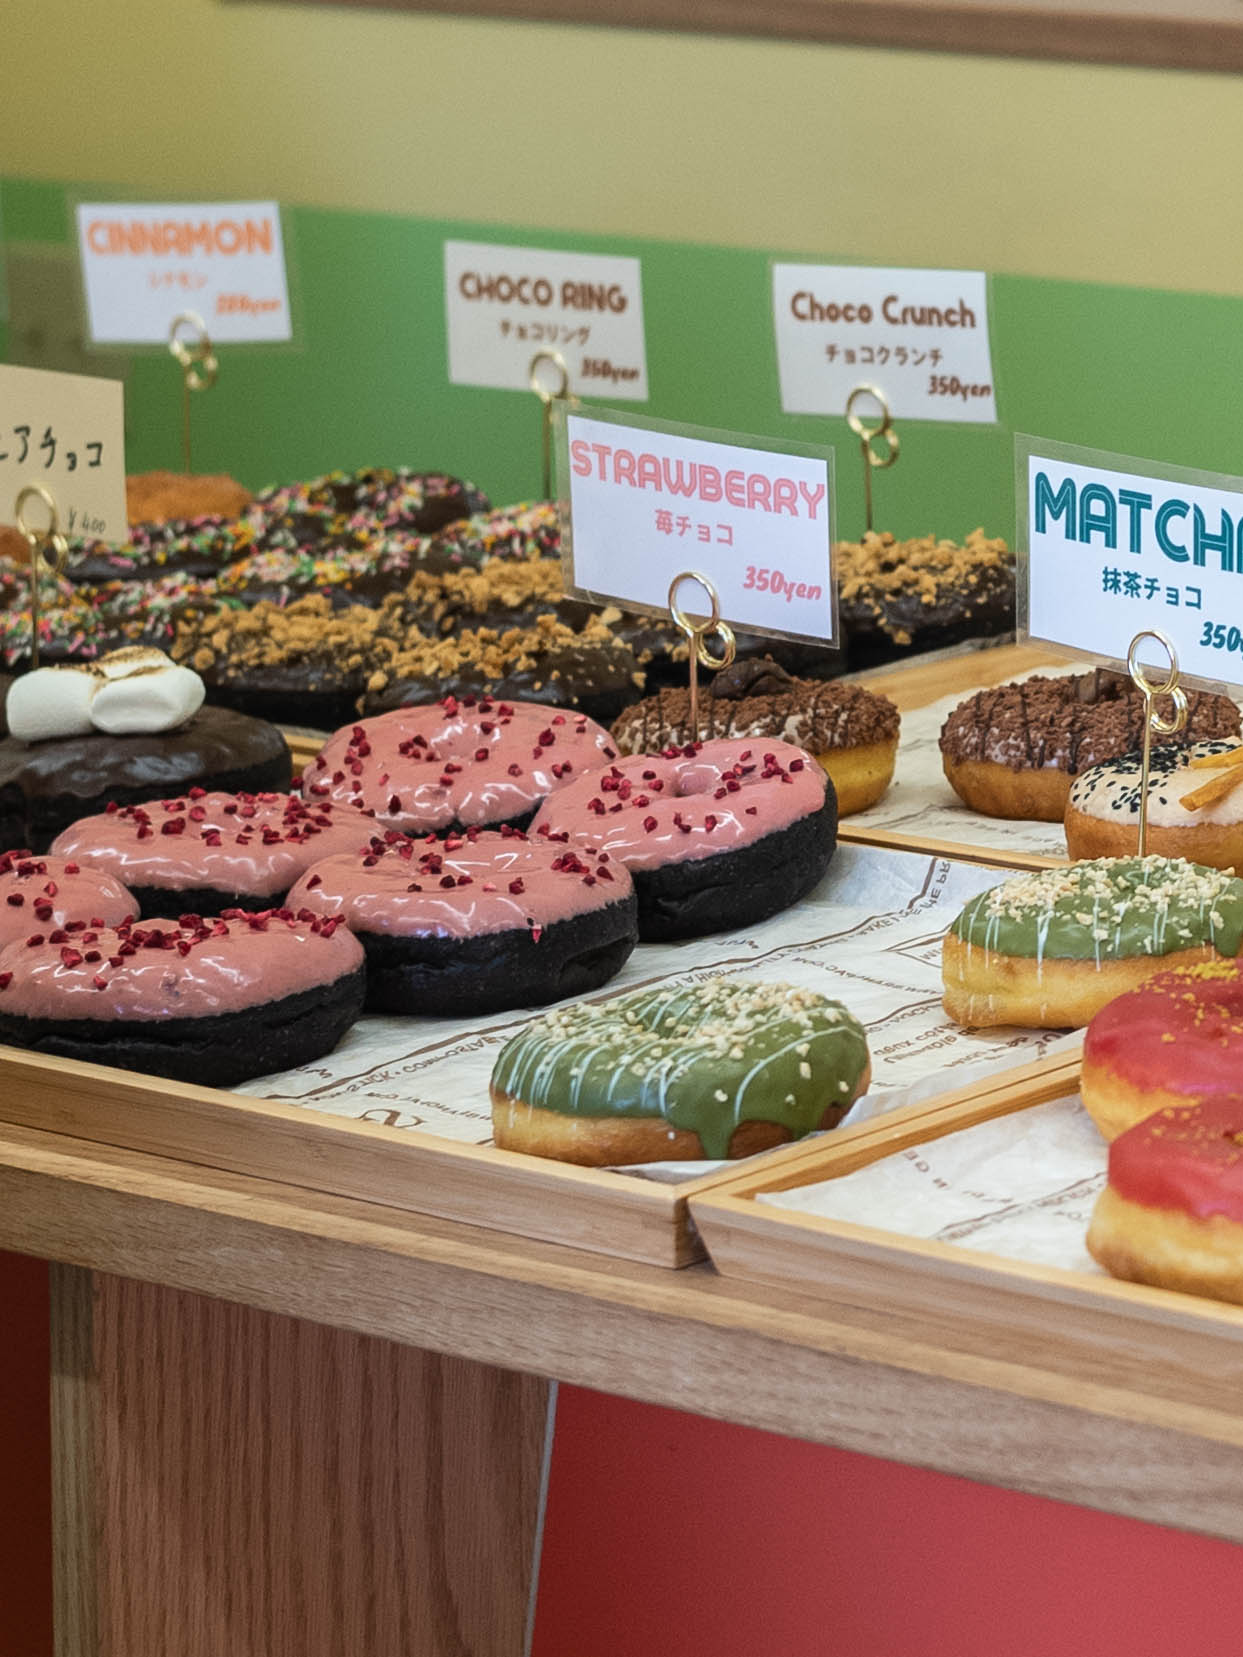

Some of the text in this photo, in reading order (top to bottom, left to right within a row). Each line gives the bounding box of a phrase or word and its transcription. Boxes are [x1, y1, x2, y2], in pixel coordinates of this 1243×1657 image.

[87, 219, 272, 255] CINNAMON
[459, 272, 628, 313] CHOCO RING
[791, 291, 976, 328] Choco Crunch
[500, 319, 591, 344] チョコリング
[581, 357, 639, 384] 350yen
[825, 344, 943, 367] チョコクランチ
[928, 375, 991, 401] 350yen
[571, 440, 825, 519] STRAWBERRY
[654, 509, 734, 546] 苺チョコ
[743, 566, 822, 602] 350yen
[1102, 566, 1202, 609] 抹茶チョコ
